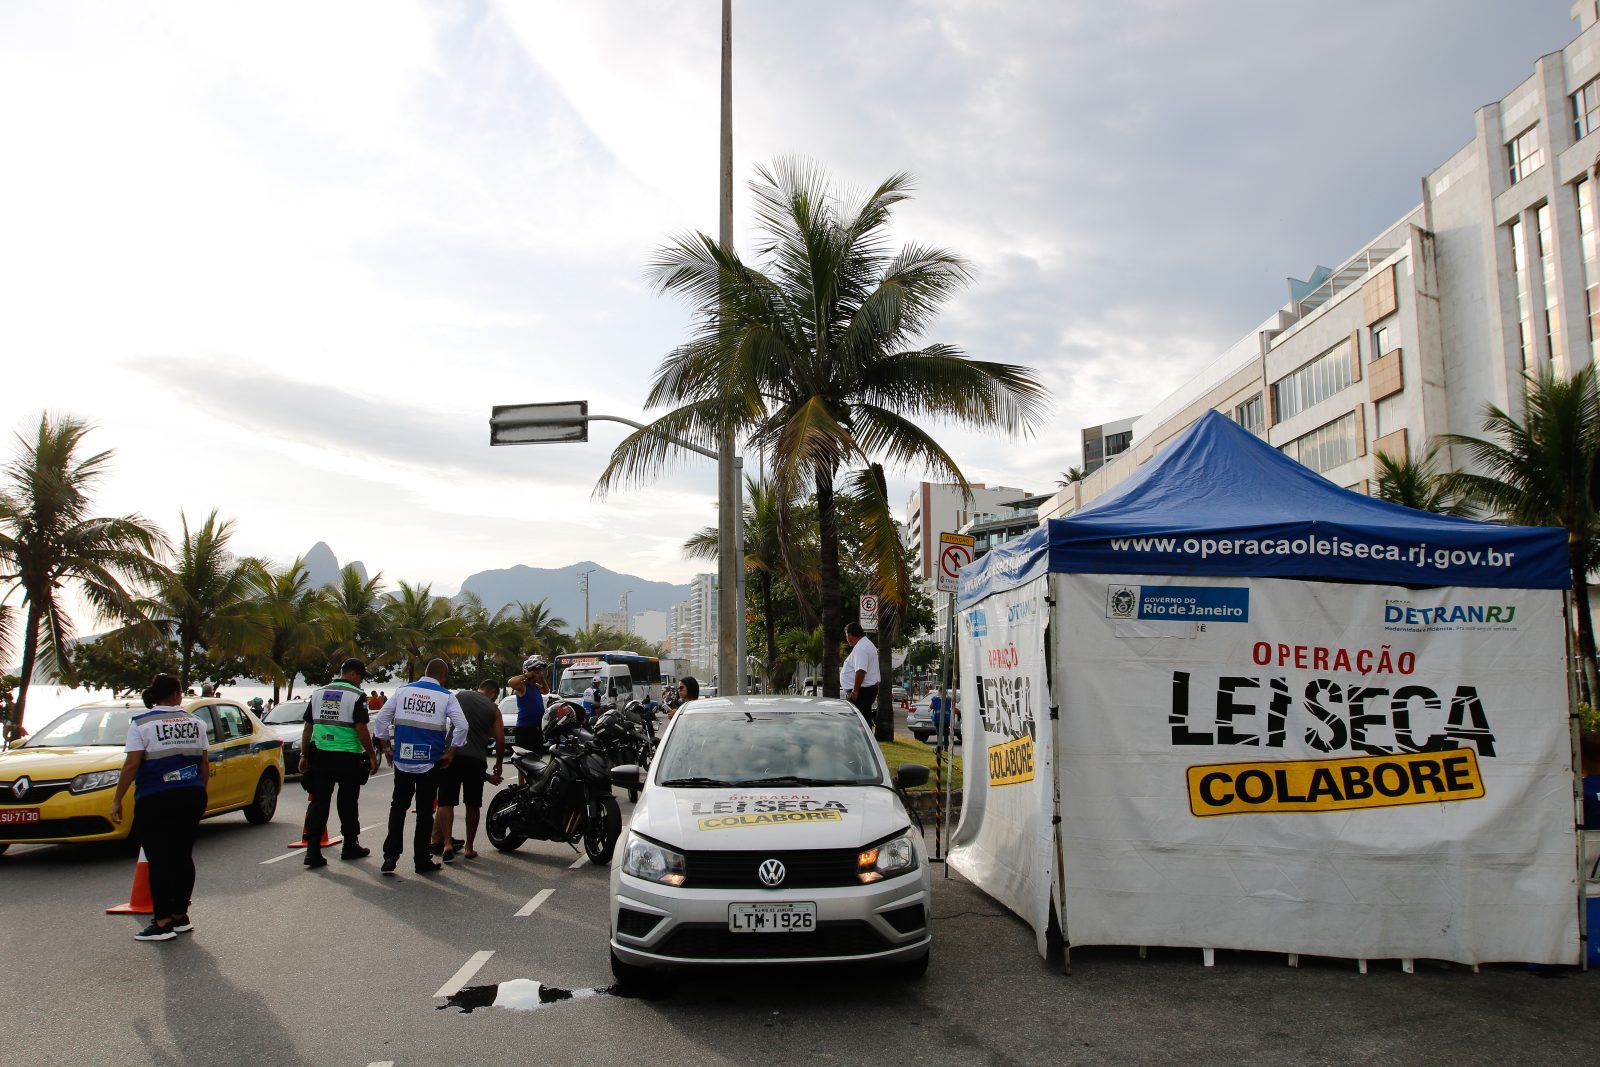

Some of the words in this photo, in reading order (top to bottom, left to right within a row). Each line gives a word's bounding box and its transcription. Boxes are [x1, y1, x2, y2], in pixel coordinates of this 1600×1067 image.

[1111, 534, 1514, 568] www.operacaoleiseca.rj.gov.br
[1143, 603, 1165, 614] Rio
[1169, 604, 1186, 614] de
[1188, 604, 1242, 616] Janeiro
[1253, 641, 1416, 676] OPERAÇÃO
[403, 697, 416, 711] LEI
[416, 700, 436, 714] SECA
[1169, 671, 1292, 747] LEI
[1303, 678, 1496, 757] SECA
[155, 724, 173, 741] LEI
[174, 722, 200, 740] SECA
[990, 742, 1033, 779] COLABORE
[1200, 756, 1474, 806] COLABORE
[691, 801, 747, 815] LEI
[754, 800, 848, 813] SECA
[0, 813, 38, 822] SU-7130
[704, 812, 836, 828] COLABORE
